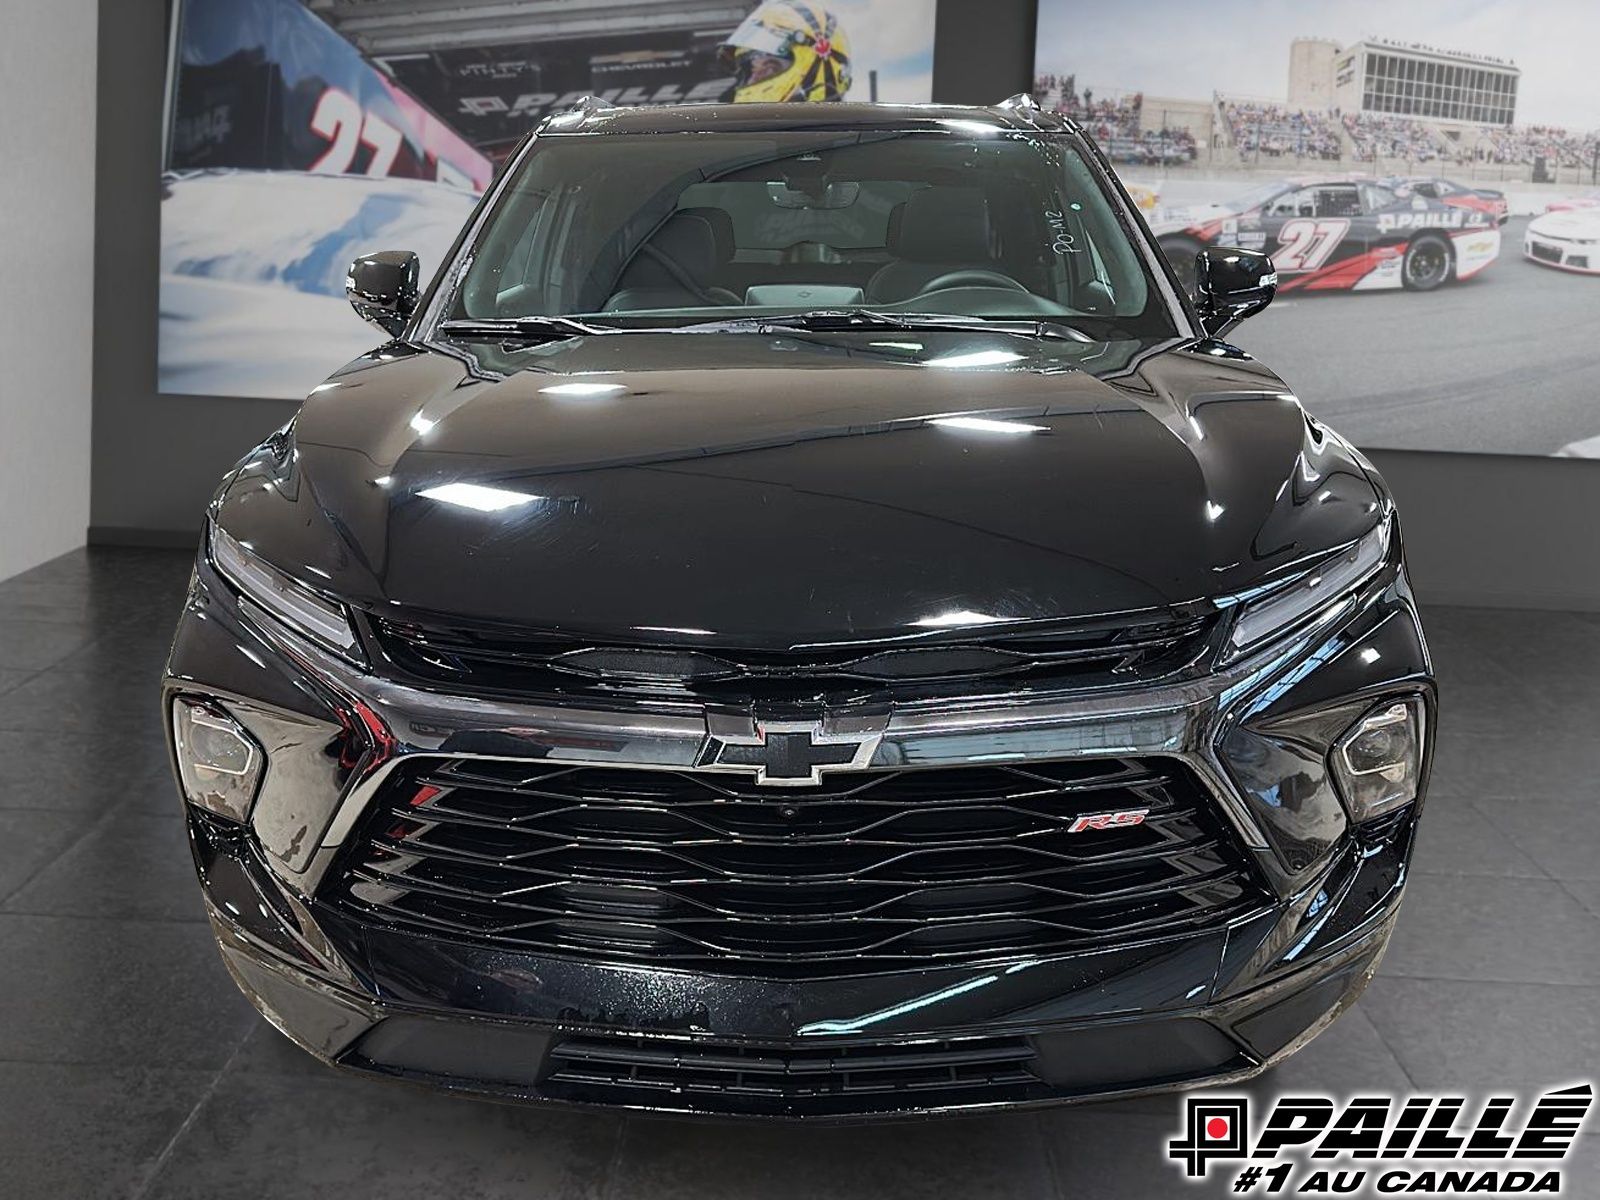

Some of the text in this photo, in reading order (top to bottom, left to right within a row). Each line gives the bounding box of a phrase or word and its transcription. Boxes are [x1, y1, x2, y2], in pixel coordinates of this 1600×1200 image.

[308, 87, 403, 175] 27
[1269, 217, 1351, 274] 27
[1067, 809, 1150, 833] RS
